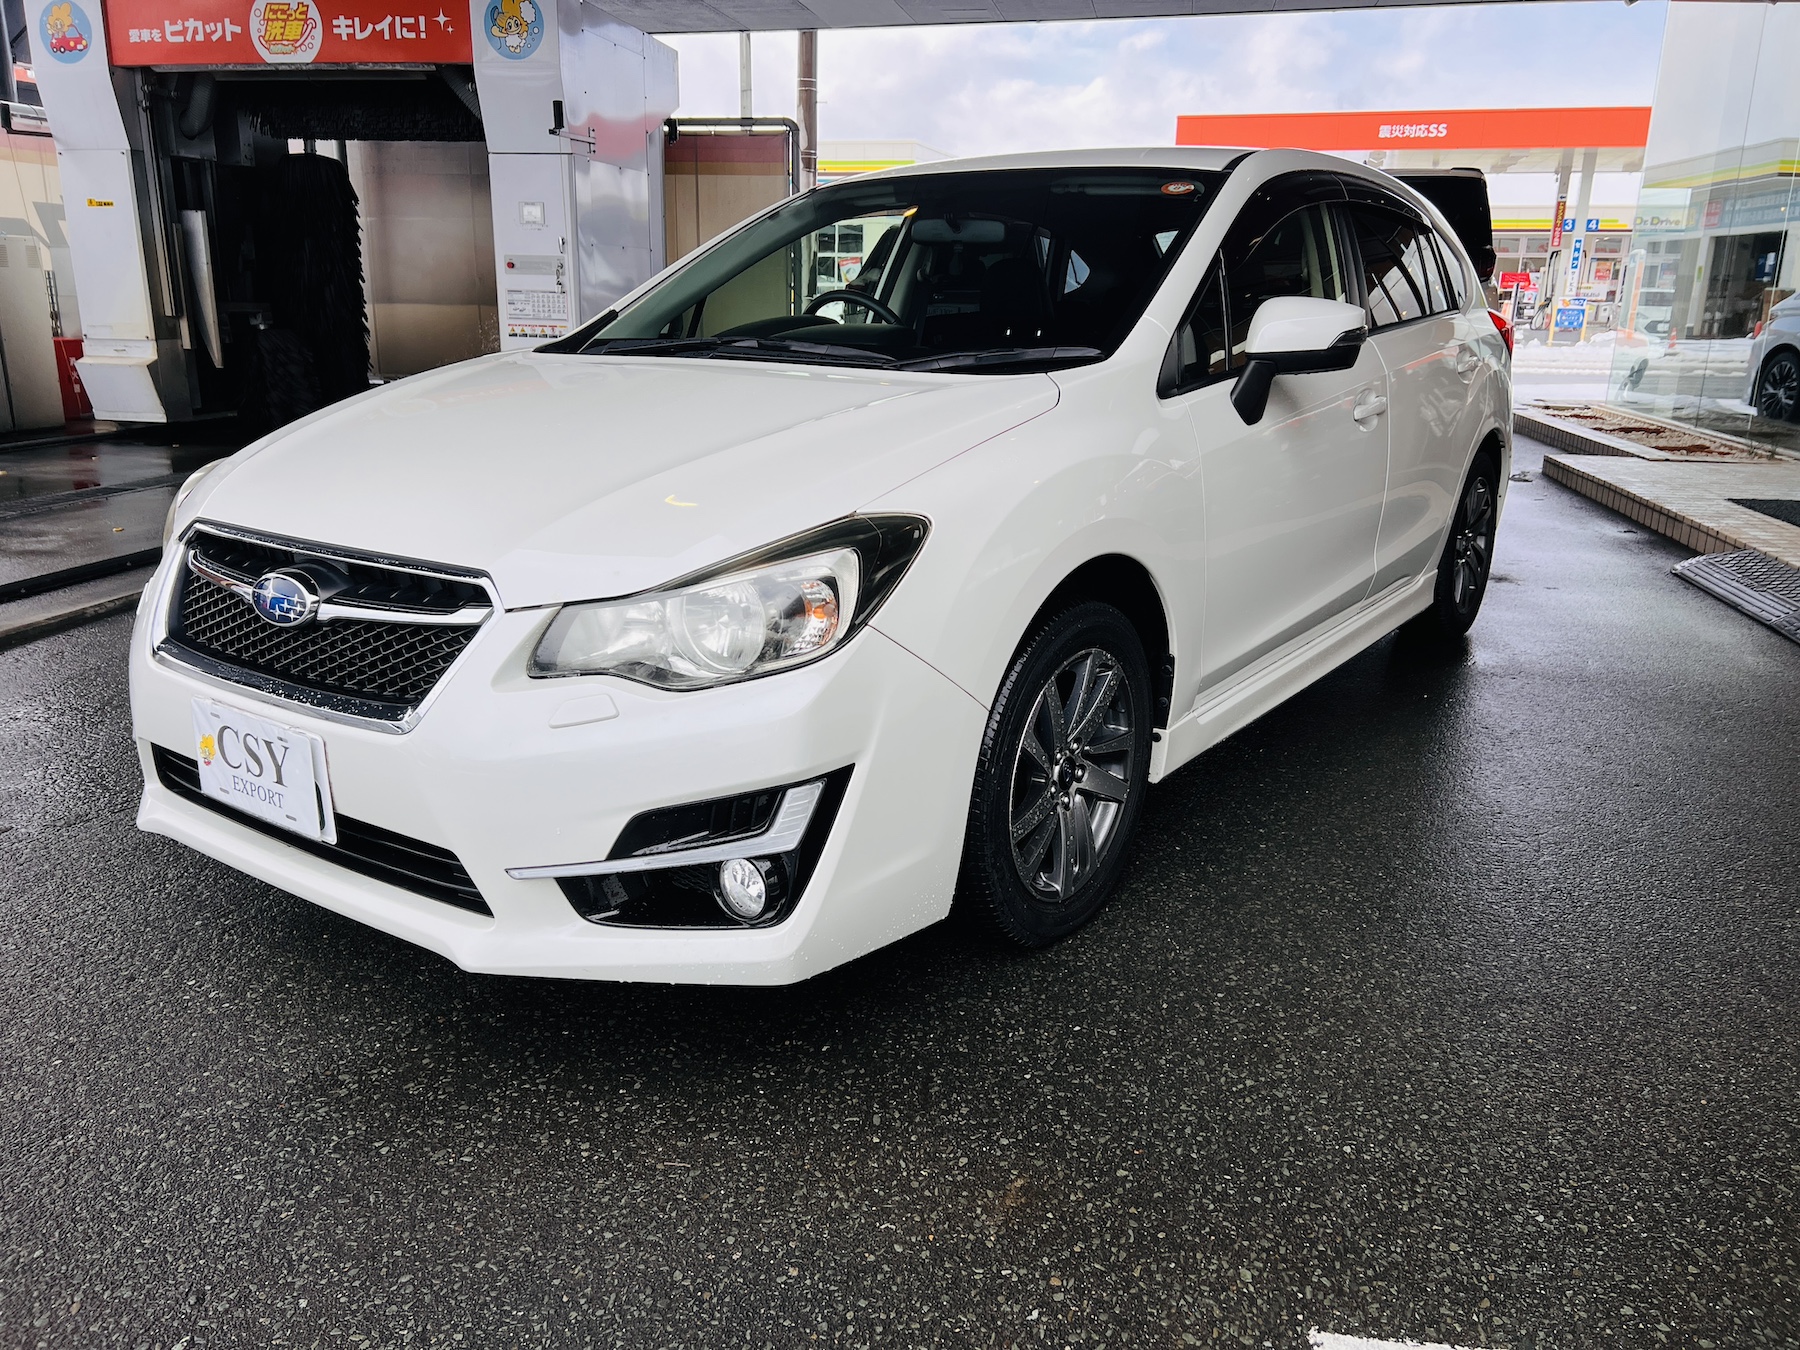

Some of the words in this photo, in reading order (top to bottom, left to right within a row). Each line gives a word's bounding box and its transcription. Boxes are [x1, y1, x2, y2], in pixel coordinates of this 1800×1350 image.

[264, 3, 308, 20] にこっと
[264, 21, 304, 40] 洗車
[332, 14, 426, 41] キレイに!
[1378, 123, 1448, 138] 震災対応SS
[1564, 219, 1573, 230] 3
[1588, 219, 1597, 230] 4
[217, 725, 290, 788] CSY
[232, 775, 284, 809] EXPORT
